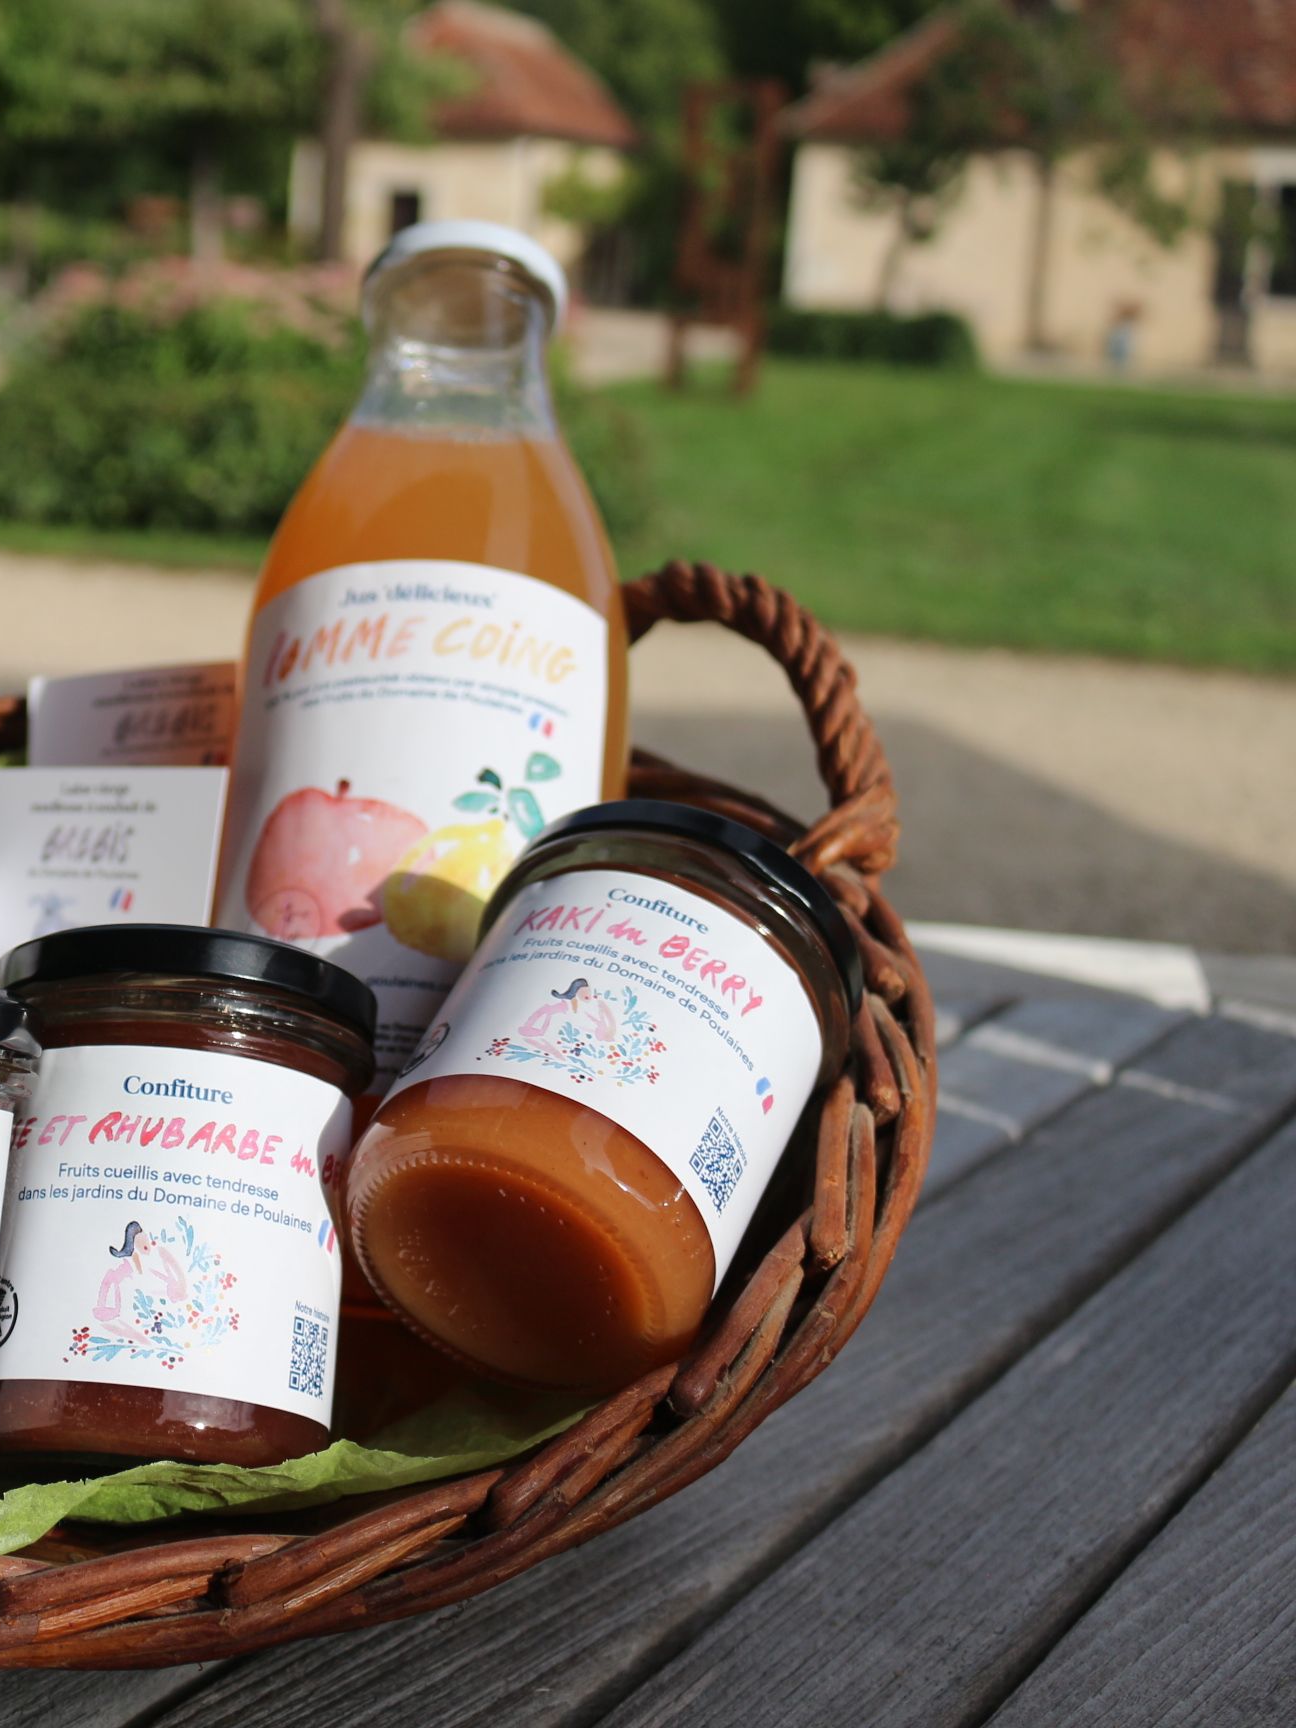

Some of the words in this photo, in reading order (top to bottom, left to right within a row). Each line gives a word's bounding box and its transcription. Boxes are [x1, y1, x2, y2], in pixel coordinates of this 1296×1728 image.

[607, 887, 709, 935] Confiture
[522, 936, 564, 949] Fruits
[566, 940, 619, 959] cueillis
[621, 953, 659, 974] avec
[661, 969, 730, 1021] tendresse
[659, 935, 763, 1017] BERRY
[527, 949, 580, 963] jardins
[583, 956, 604, 970] du
[607, 961, 676, 999] Domaine
[678, 997, 697, 1014] de
[700, 1009, 754, 1072] Poulaines
[123, 1075, 233, 1104] Confiture
[38, 1114, 88, 1146] ET
[88, 1111, 284, 1165] RHUBARBE
[716, 1106, 733, 1133] Notre
[58, 1162, 100, 1178] Fruits
[103, 1165, 159, 1181] cueillis
[163, 1170, 202, 1186] avec
[206, 1174, 279, 1201] tendresse
[18, 1186, 46, 1201] dans
[49, 1184, 69, 1199] les
[71, 1184, 123, 1202] jardins
[127, 1186, 148, 1201] du
[154, 1187, 227, 1211] Domaine
[230, 1200, 250, 1216] de
[254, 1203, 312, 1233] Poulaines
[295, 1300, 313, 1316] Notre
